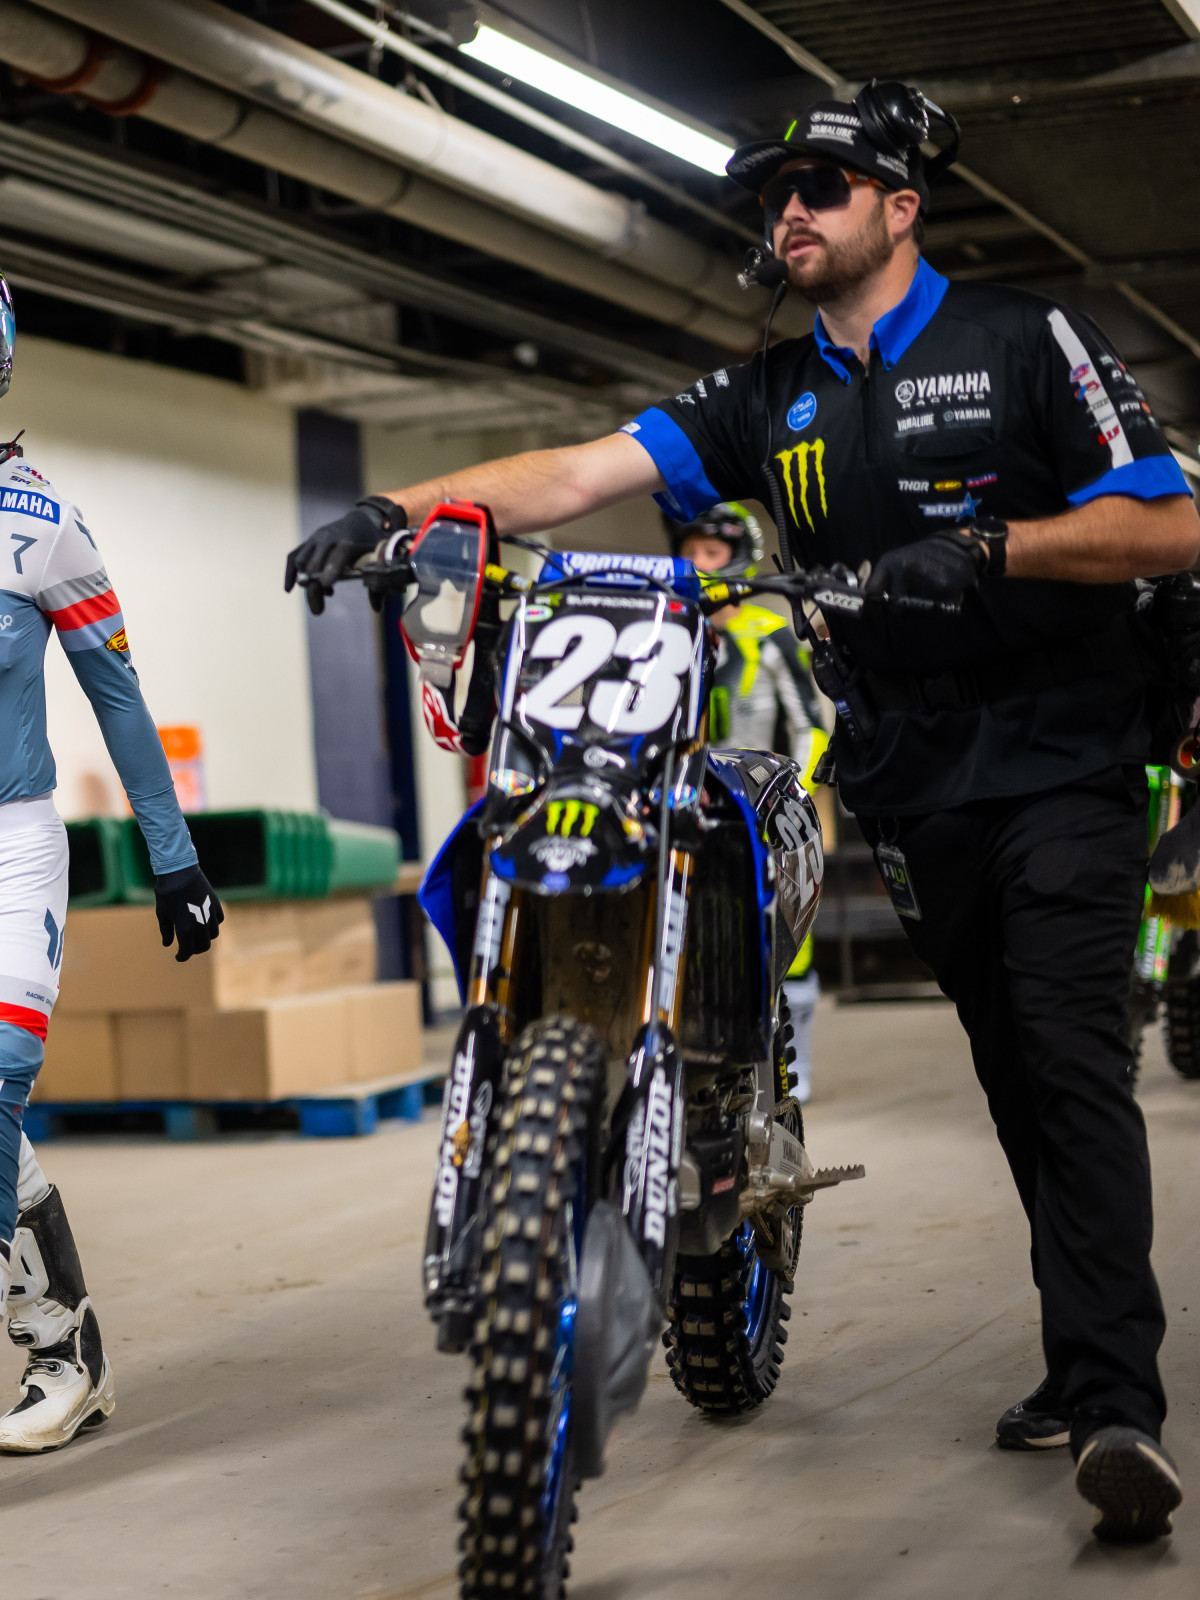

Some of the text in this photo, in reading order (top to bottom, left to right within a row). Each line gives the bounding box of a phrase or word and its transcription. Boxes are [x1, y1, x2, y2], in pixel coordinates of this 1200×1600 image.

[810, 124, 853, 138] YAMALUBE
[916, 370, 991, 399] YAMAHA
[902, 393, 985, 410] RACING
[897, 413, 935, 432] YAMALUBE
[954, 408, 991, 421] YAMAHA
[898, 479, 930, 492] THOR
[523, 614, 694, 733] 23
[26, 991, 45, 1002] RACING
[644, 1066, 672, 1249] DUNLOP
